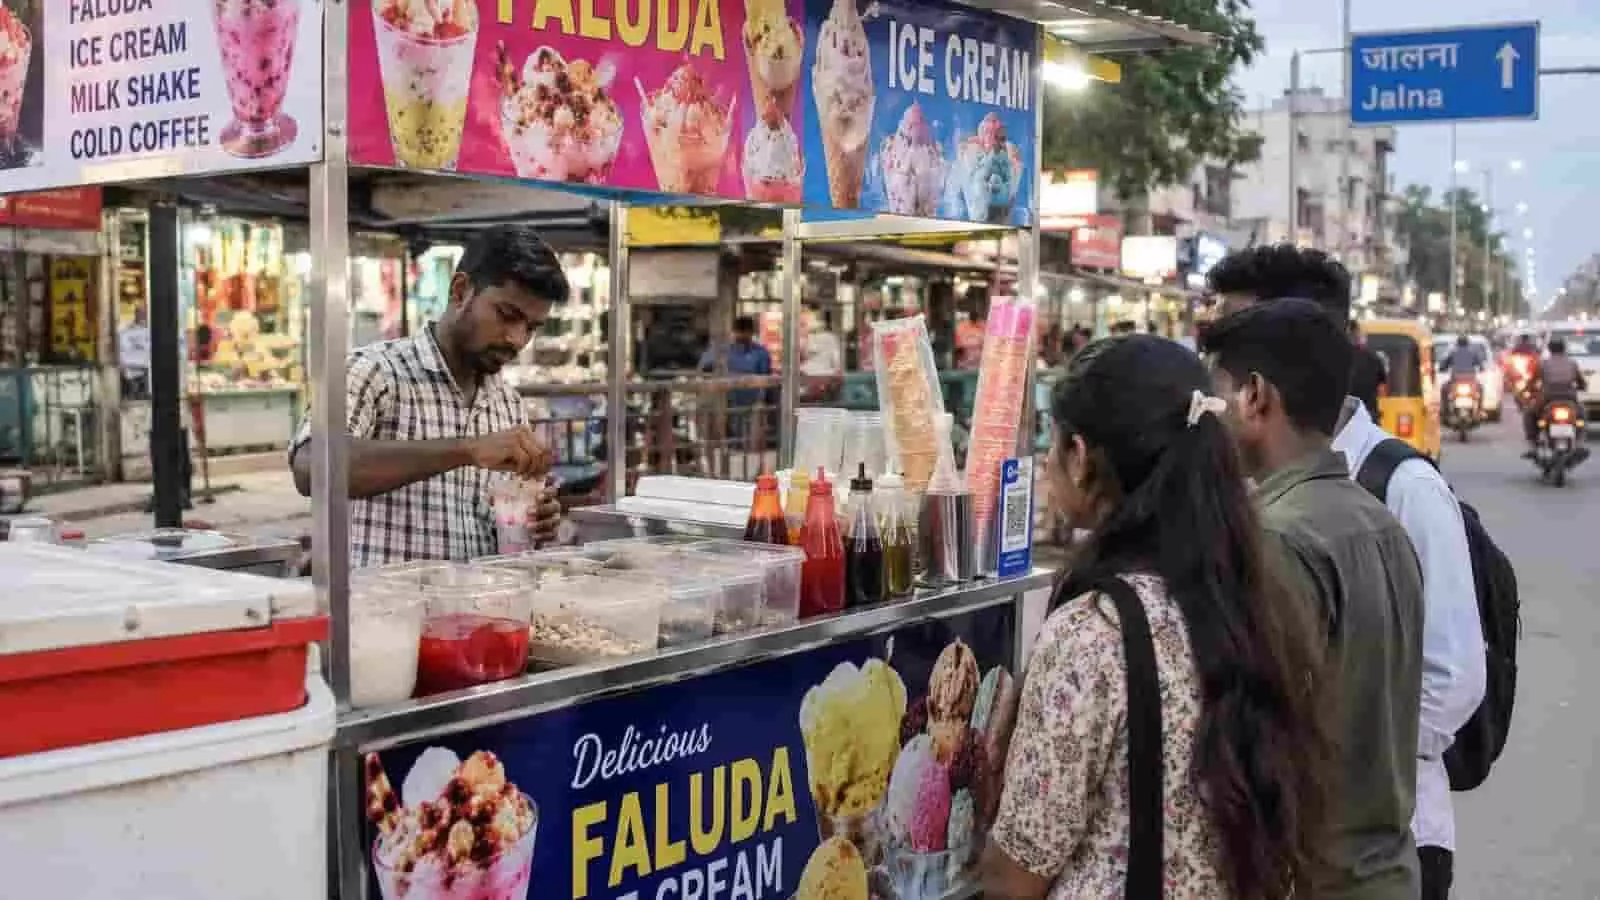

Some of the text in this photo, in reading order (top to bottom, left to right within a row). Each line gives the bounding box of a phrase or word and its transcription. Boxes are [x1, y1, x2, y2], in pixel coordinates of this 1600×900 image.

[70, 0, 153, 24] FALU
[497, 0, 726, 61] UDA
[70, 22, 187, 69] ICE CREAM
[888, 20, 1030, 111] ICE CREAM
[1360, 43, 1464, 71] जालना
[71, 67, 201, 115] MILK SHAKE
[1361, 83, 1444, 112] Jalna
[70, 114, 211, 159] COLD COFFEE
[571, 722, 713, 789] Delicious
[572, 746, 797, 900] FALUDA
